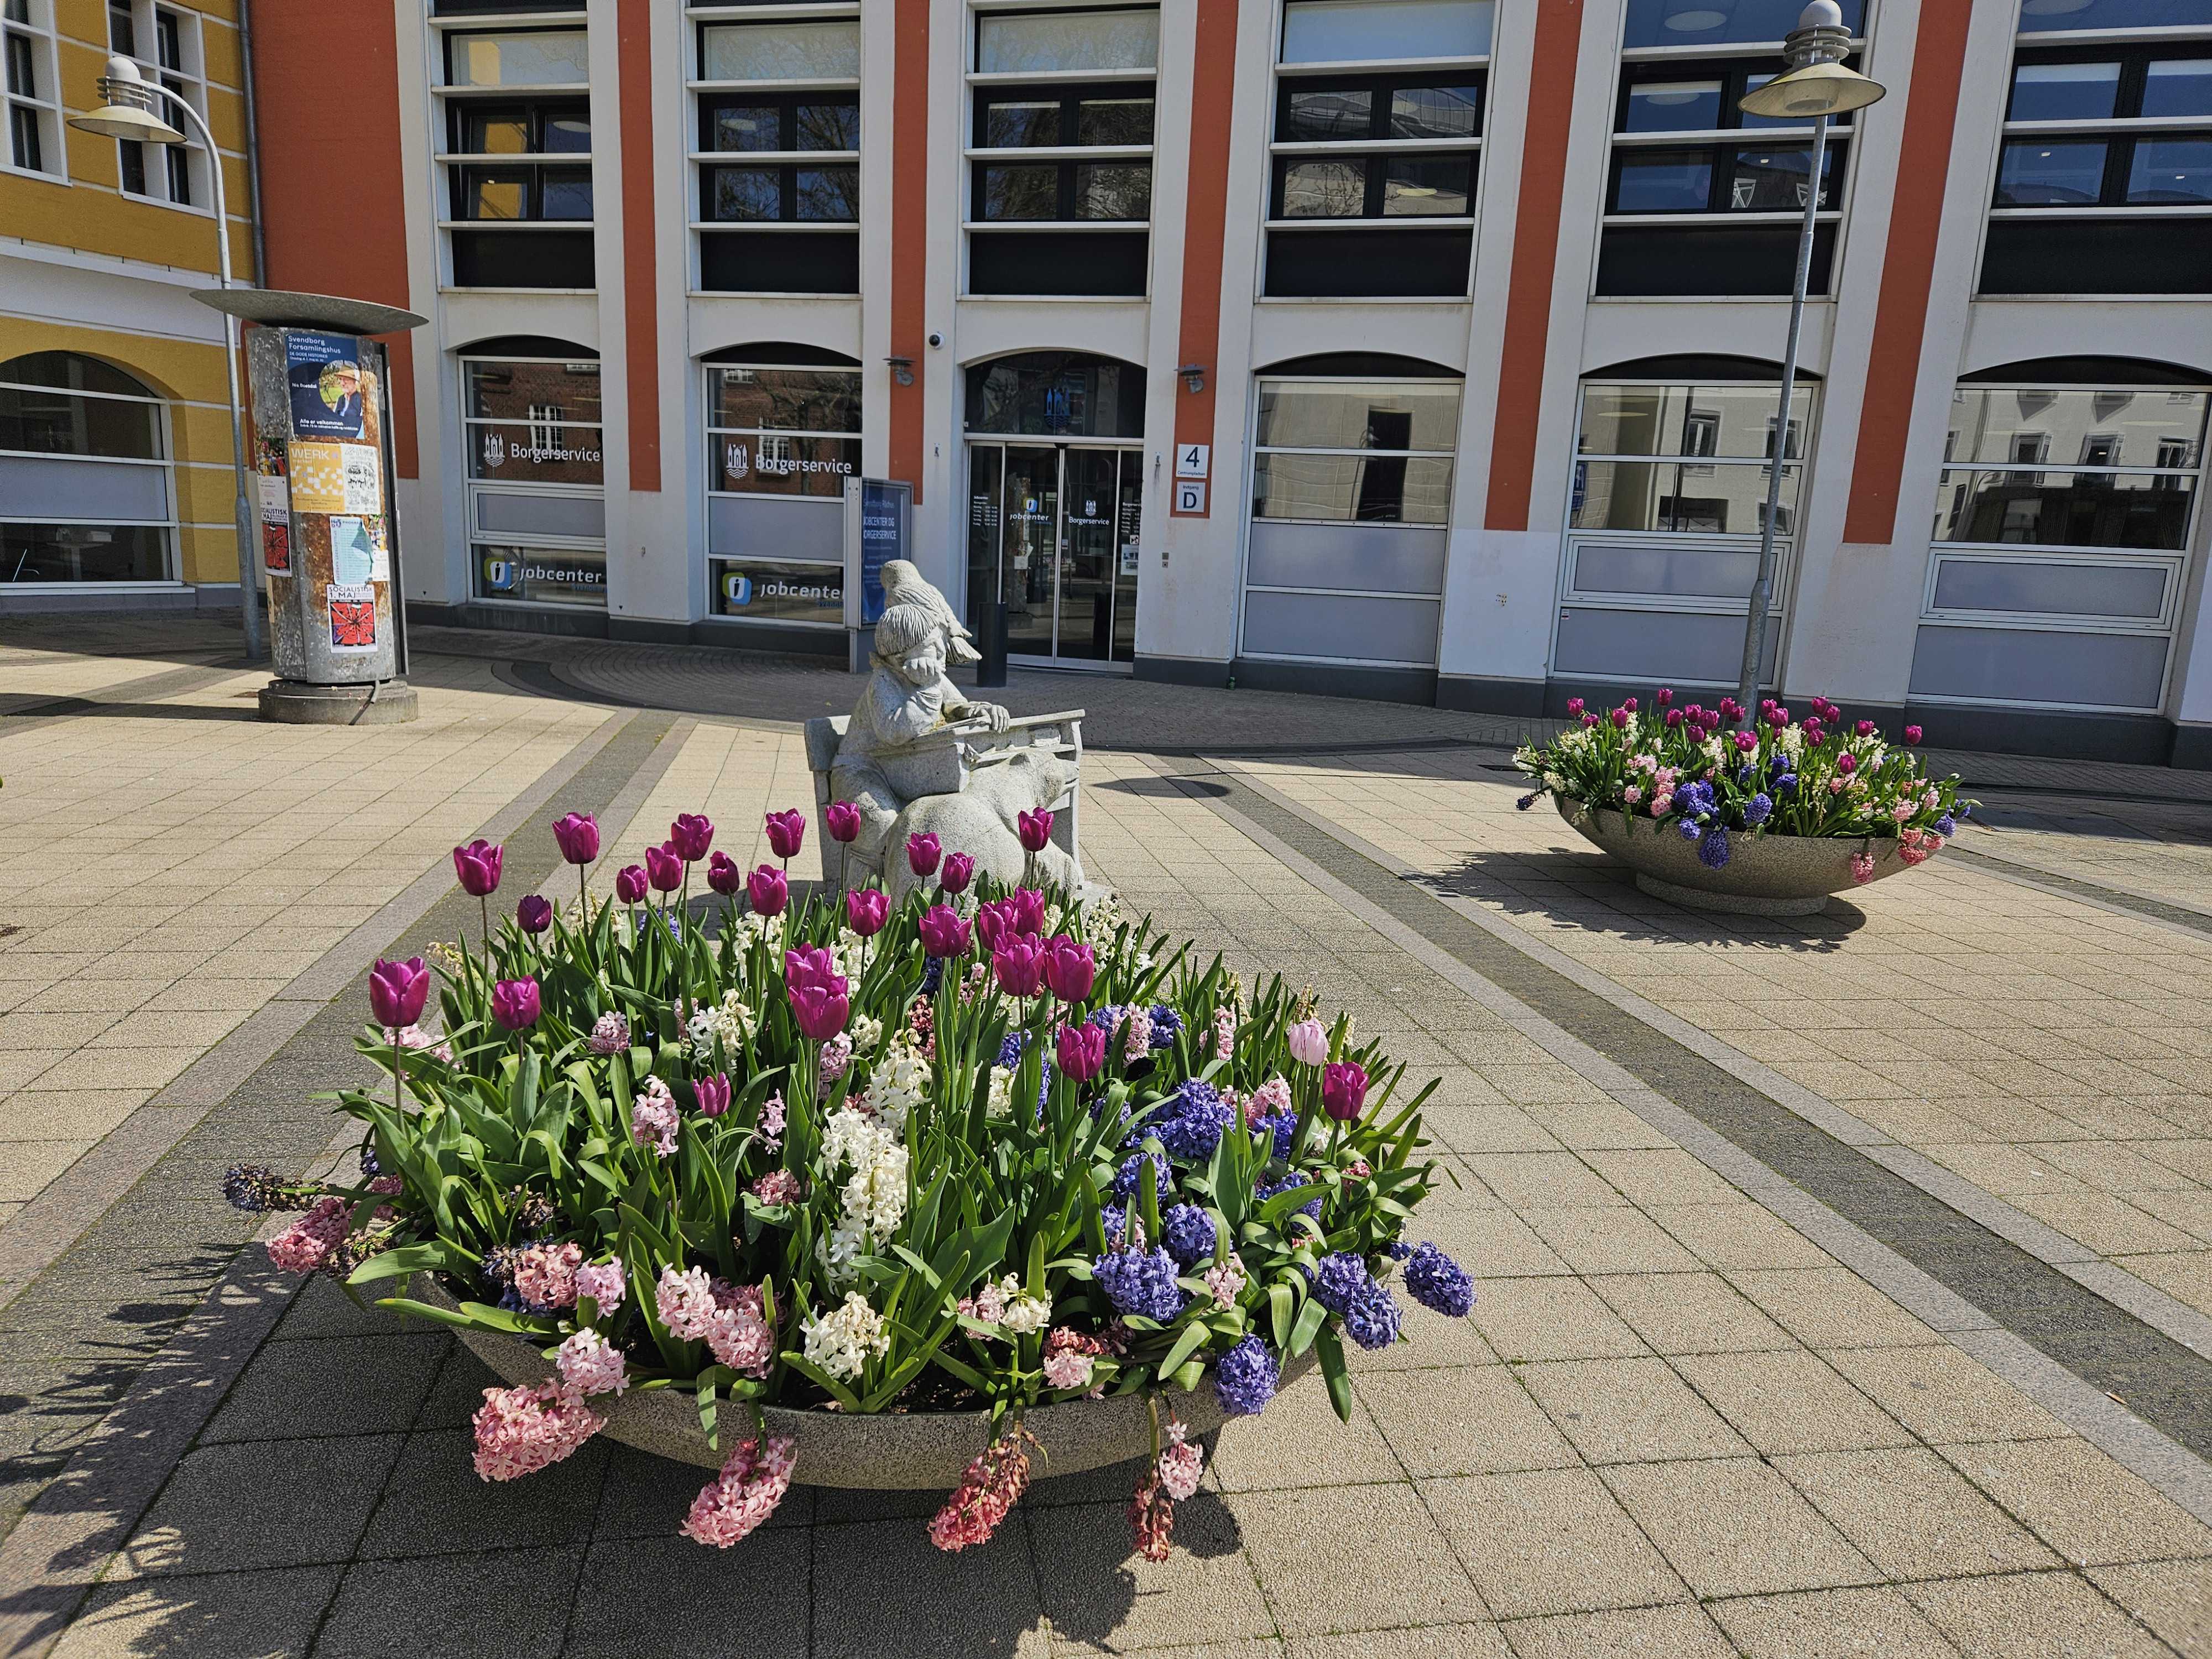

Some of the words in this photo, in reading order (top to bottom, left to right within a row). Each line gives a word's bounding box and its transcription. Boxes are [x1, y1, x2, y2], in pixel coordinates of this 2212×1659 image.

[288, 335, 325, 346] Svendborg
[289, 342, 341, 353] Forsamlingshus
[511, 443, 601, 463] Borgerservice
[1185, 447, 1199, 467] 4
[755, 454, 852, 474] Borgerservice
[1183, 492, 1197, 509] D
[863, 517, 888, 526] JOBCENTER
[888, 518, 894, 526] OG
[1068, 517, 1109, 525] Borgerservice
[520, 565, 602, 582] jobcenter
